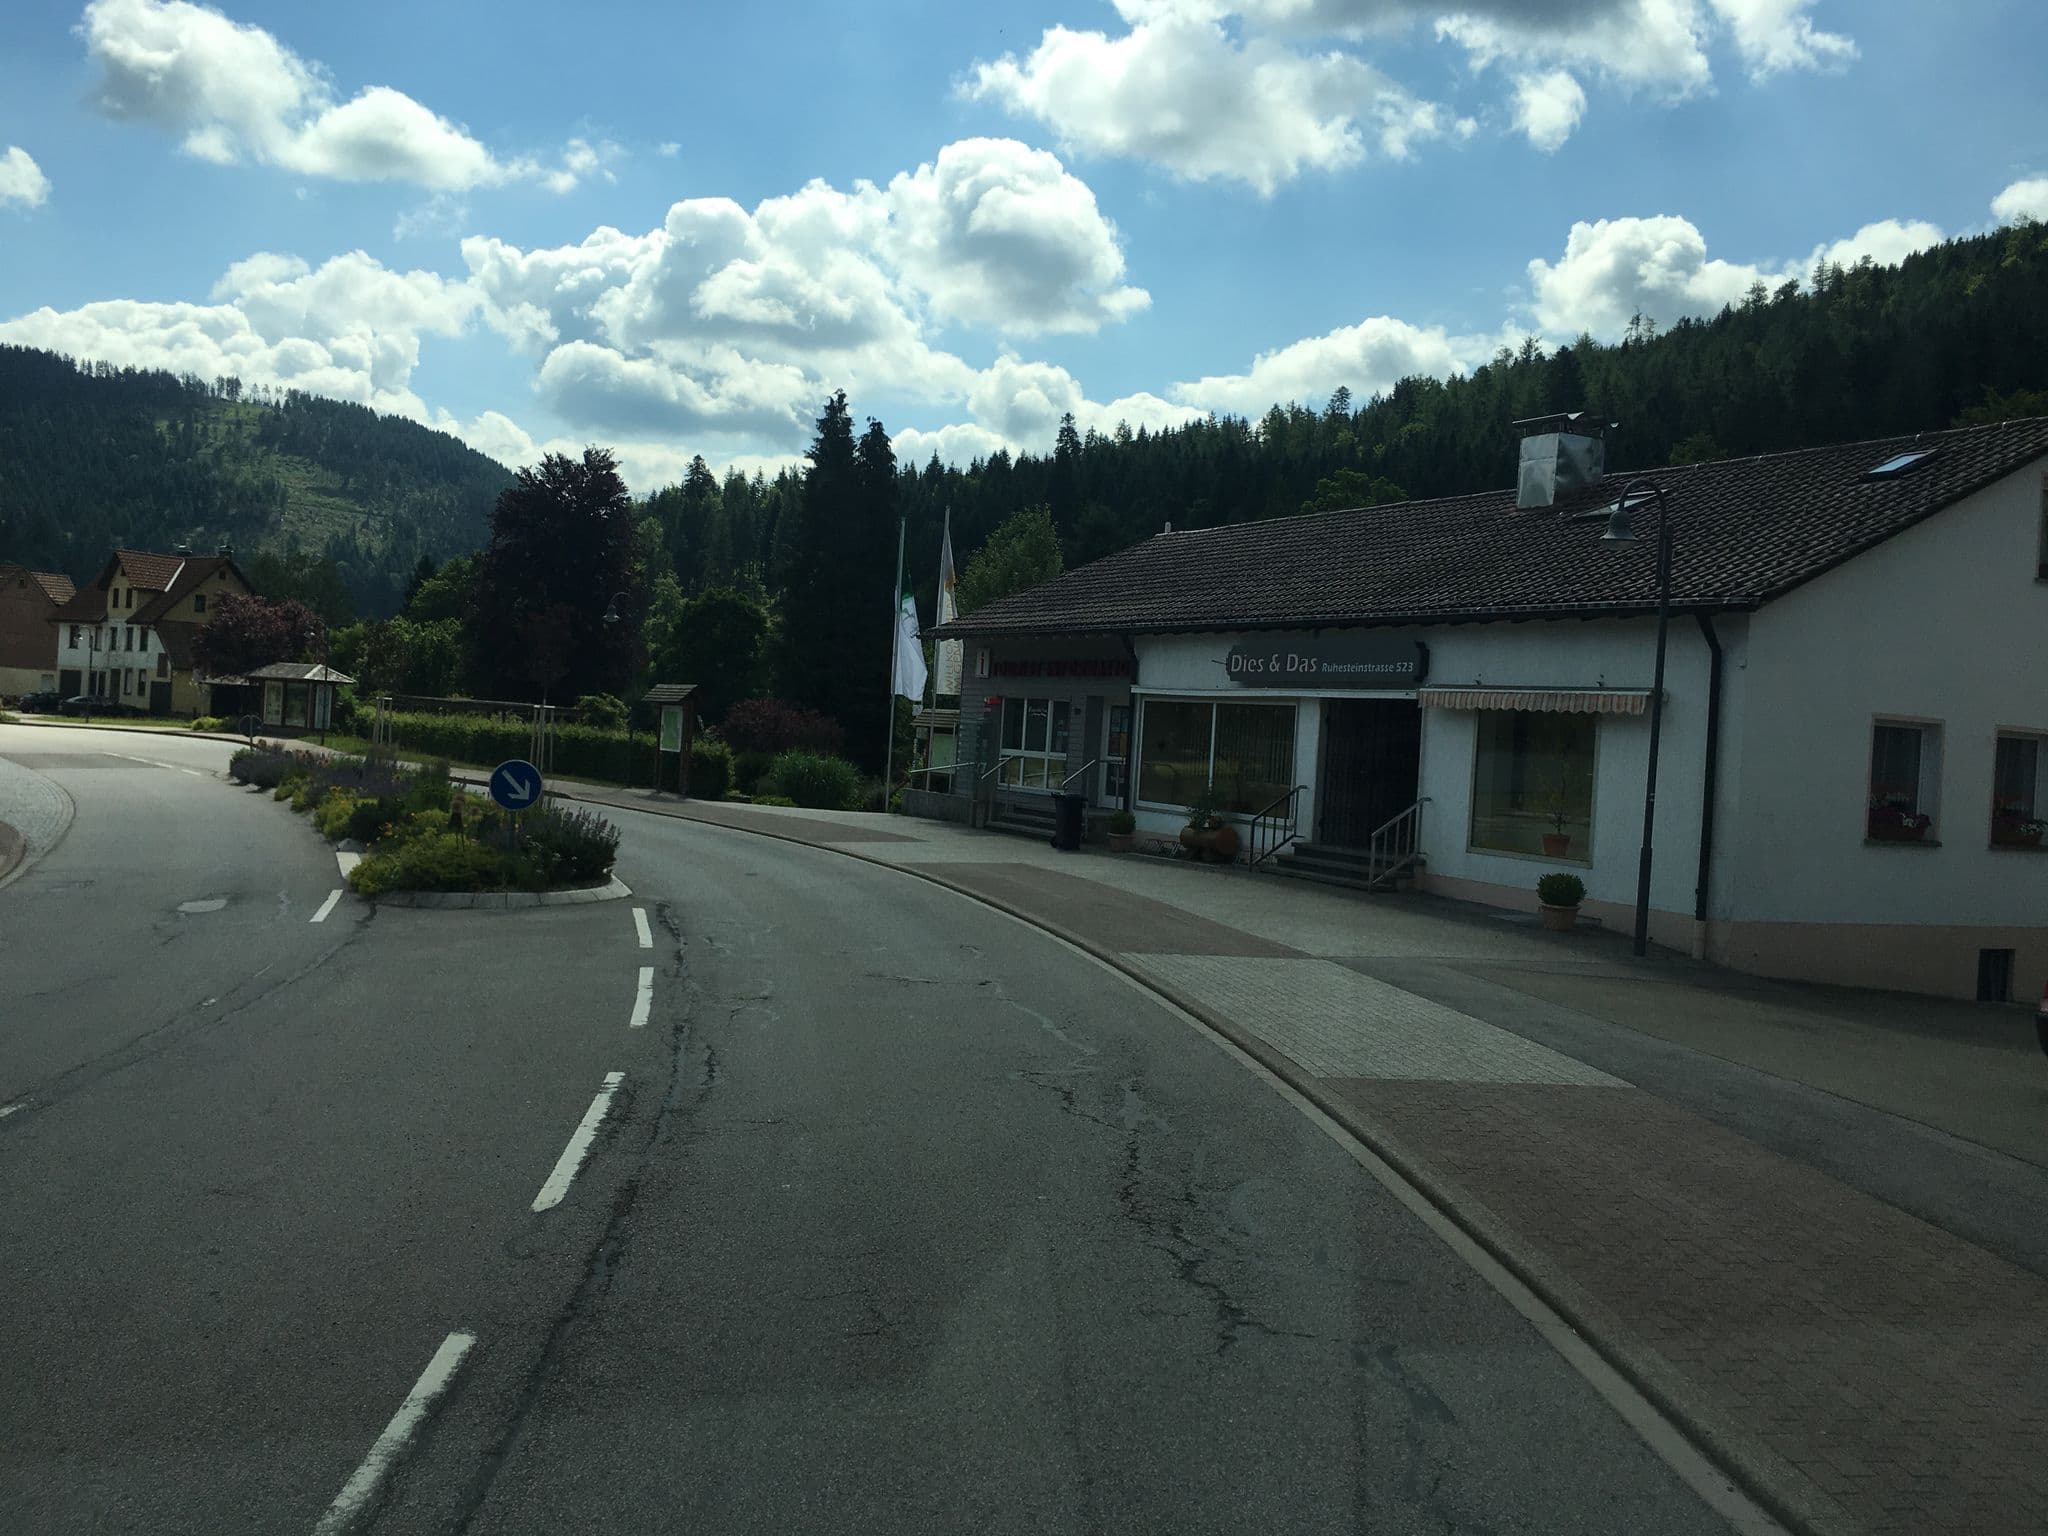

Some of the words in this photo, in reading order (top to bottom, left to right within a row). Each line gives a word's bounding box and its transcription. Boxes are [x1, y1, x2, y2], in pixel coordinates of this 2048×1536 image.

[1231, 654, 1264, 672] Dies
[1269, 653, 1280, 672] &
[1286, 653, 1318, 672] Das
[1321, 662, 1394, 673] Ruhesteinstrasse
[1396, 662, 1414, 672] 523
